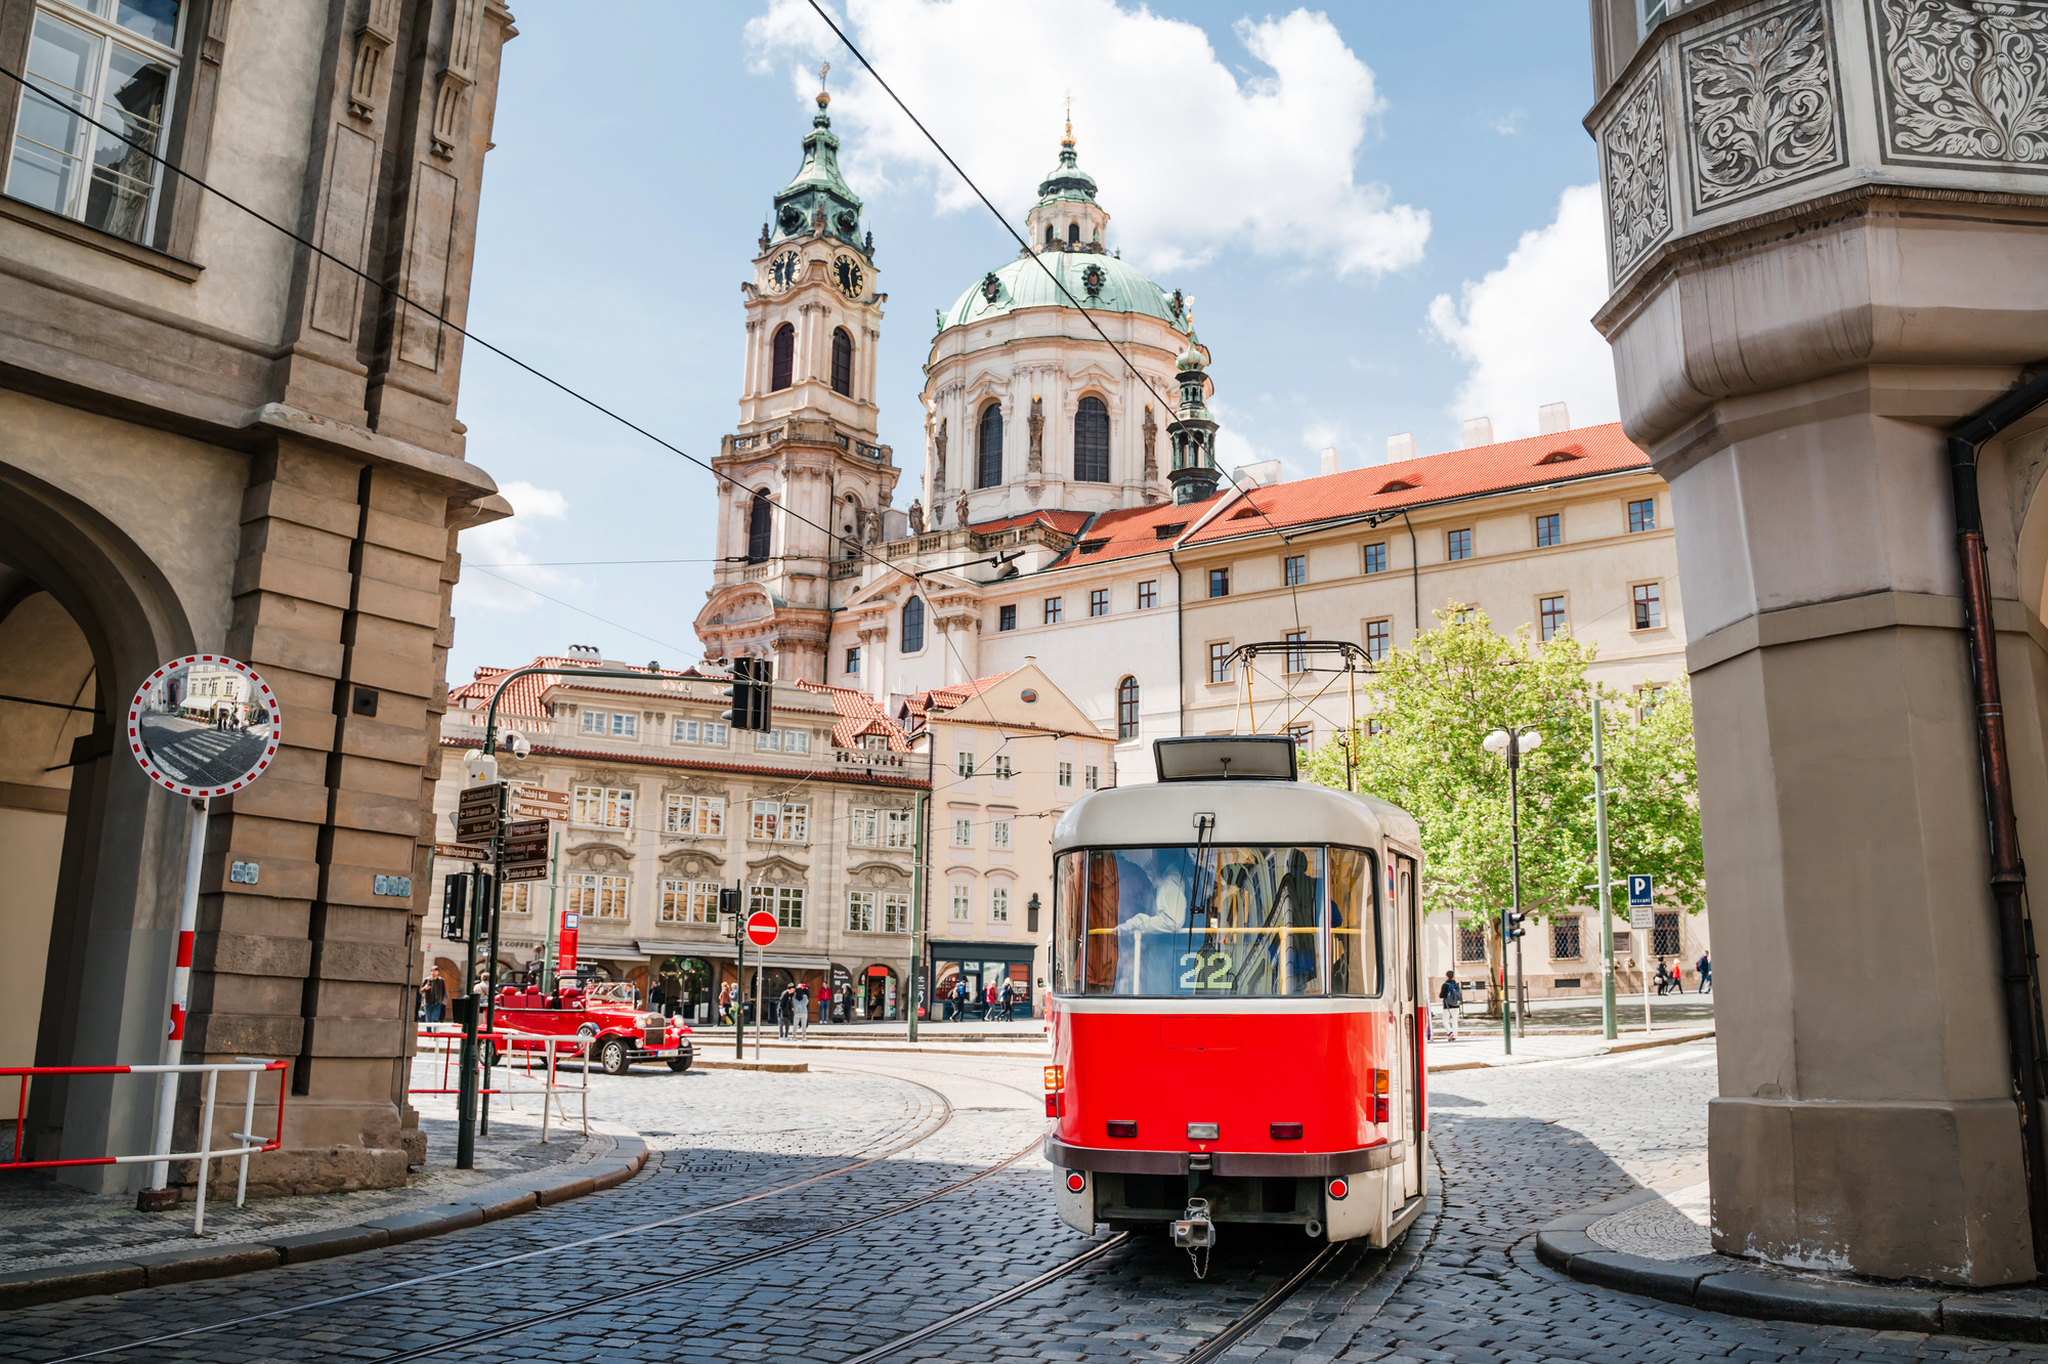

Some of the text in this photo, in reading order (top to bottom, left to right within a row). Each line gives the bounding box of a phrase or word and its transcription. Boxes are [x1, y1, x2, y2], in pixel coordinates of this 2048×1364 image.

[521, 789, 549, 800] Pražský hrad
[521, 805, 533, 815] Kostel
[442, 845, 484, 859] Valdštejnská zahrada
[1635, 878, 1646, 895] P
[1180, 952, 1232, 988] 22
